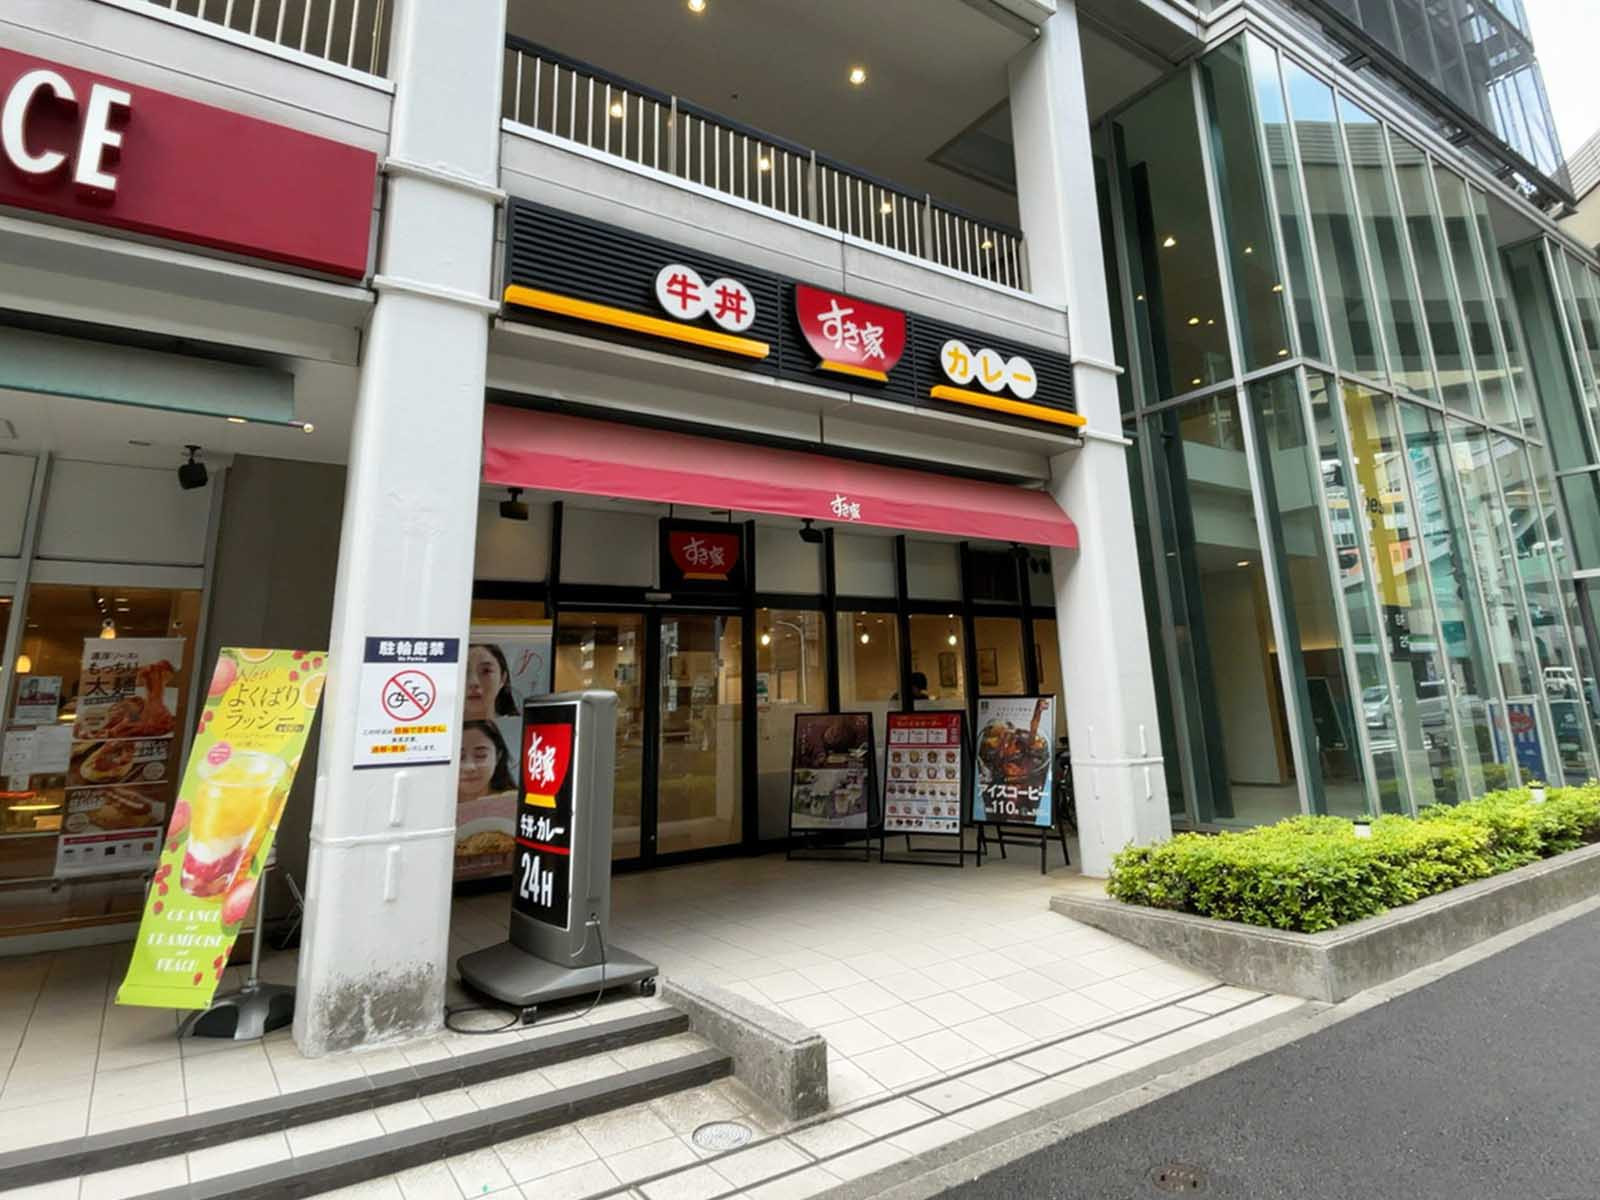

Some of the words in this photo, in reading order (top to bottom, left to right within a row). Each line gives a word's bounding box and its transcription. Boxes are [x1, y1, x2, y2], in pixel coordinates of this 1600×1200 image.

[666, 273, 748, 324] 牛丼
[817, 299, 885, 361] すき家
[947, 346, 1032, 384] カレー
[830, 494, 861, 521] すき家
[682, 537, 725, 568] すき家
[228, 683, 300, 710] よくばり
[225, 708, 295, 730] ラッシー
[528, 732, 557, 787] すき家
